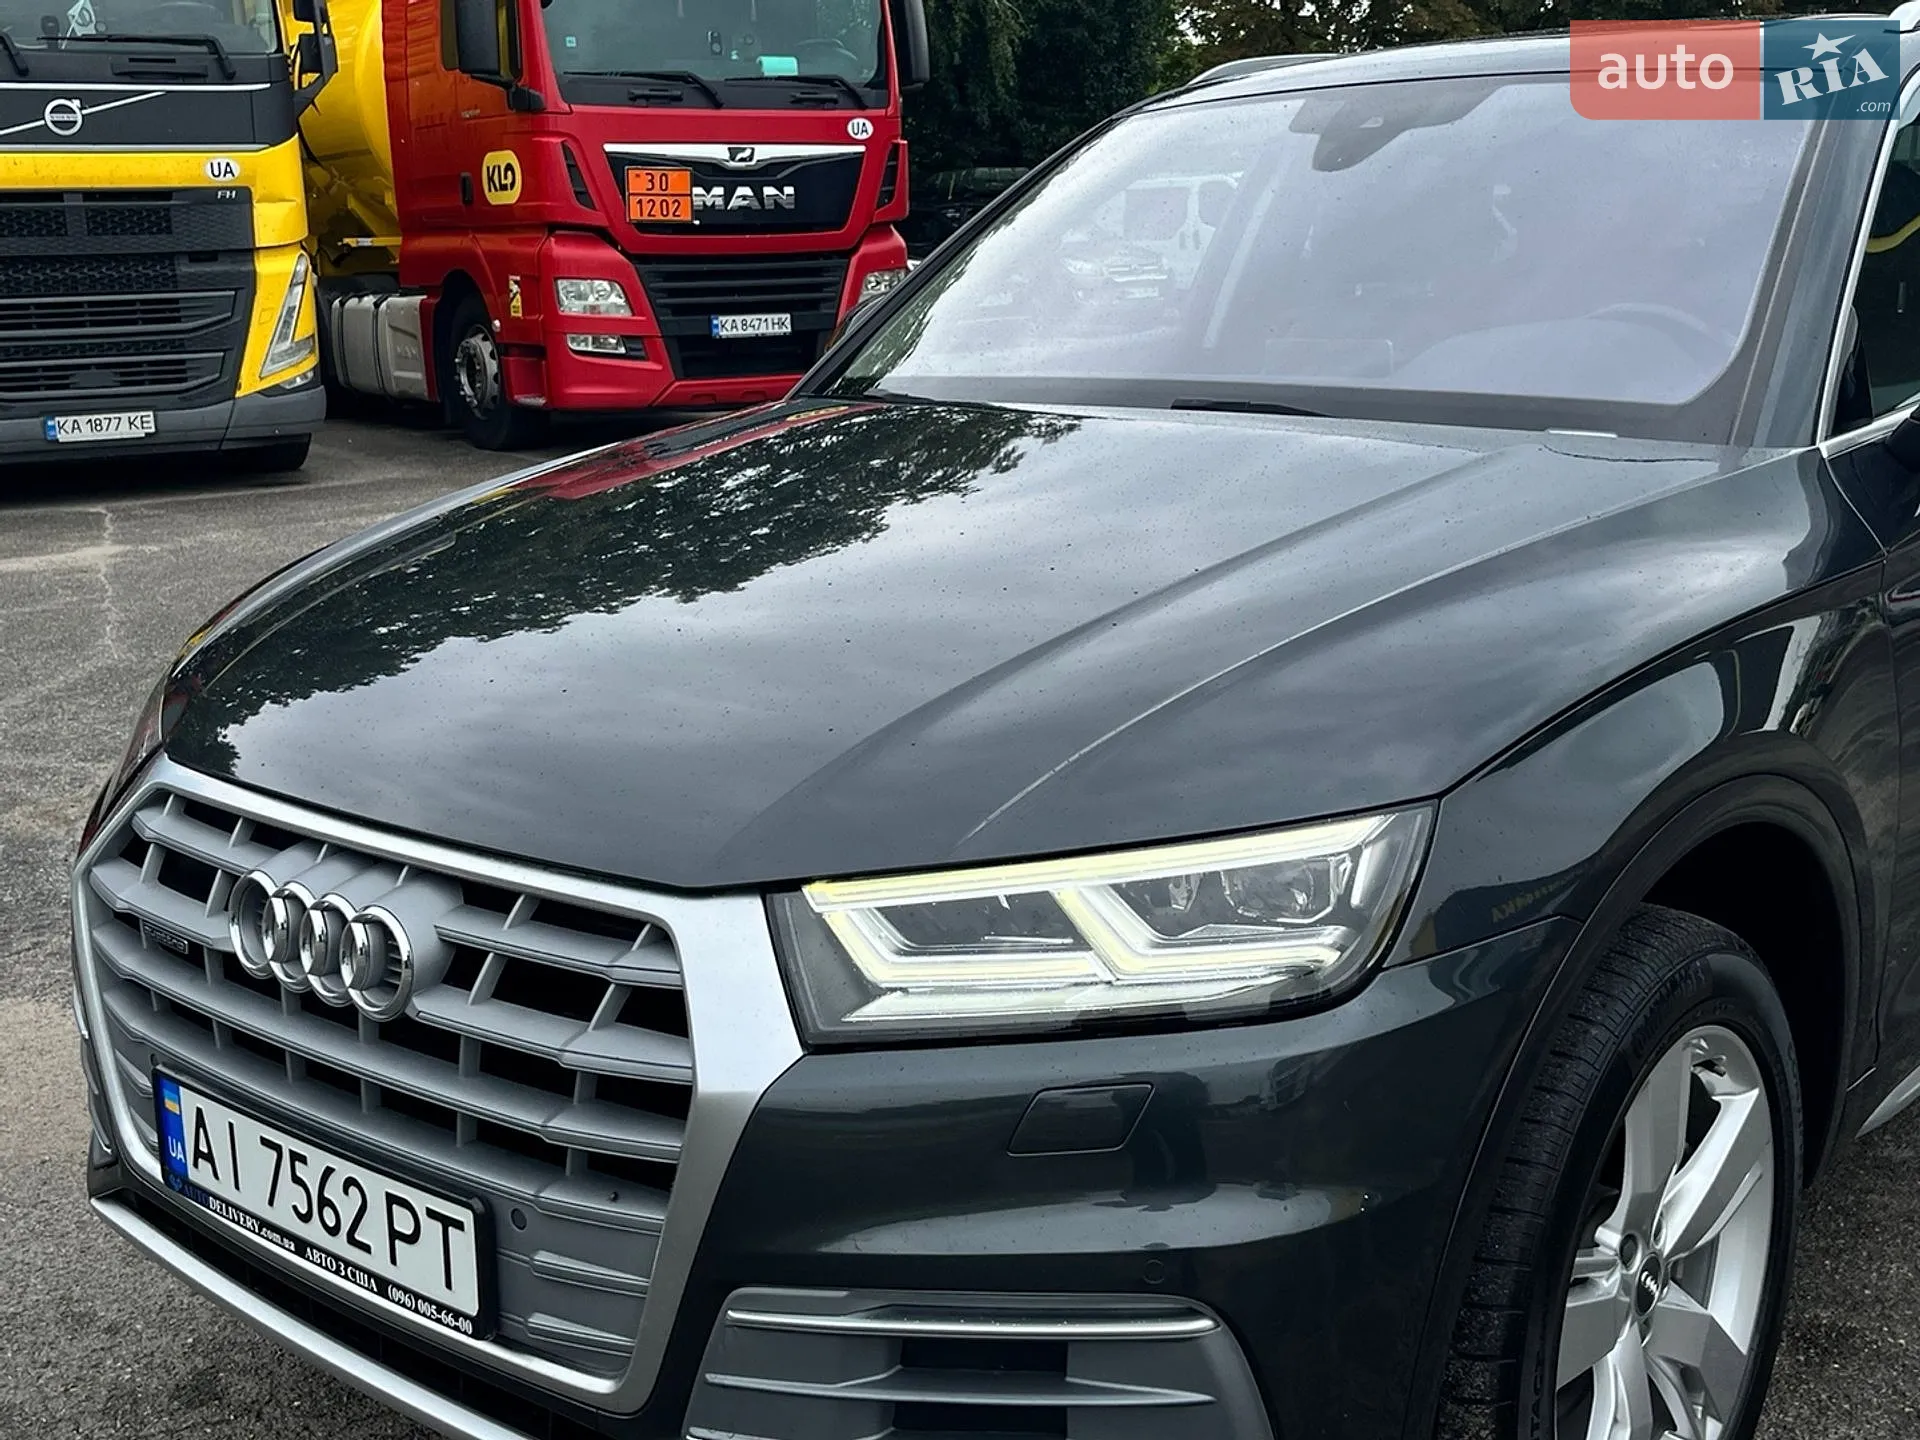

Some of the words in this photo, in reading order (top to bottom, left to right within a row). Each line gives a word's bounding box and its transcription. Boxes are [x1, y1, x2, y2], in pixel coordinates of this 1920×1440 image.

[851, 121, 869, 136] UA
[210, 161, 236, 178] UA
[486, 162, 516, 193] KLO
[645, 172, 669, 192] 30
[217, 190, 236, 199] FH
[692, 186, 796, 211] MAN
[636, 198, 682, 218] 1202
[57, 418, 82, 434] KA
[86, 416, 122, 432] 1877
[127, 414, 153, 431] KE
[168, 1136, 185, 1163] UA
[192, 1106, 240, 1191] AI
[259, 1135, 372, 1255] 7562
[384, 1190, 465, 1291] PT
[347, 1266, 378, 1293] США
[387, 1284, 416, 1310] (096)
[418, 1299, 473, 1335] 005-66-00
